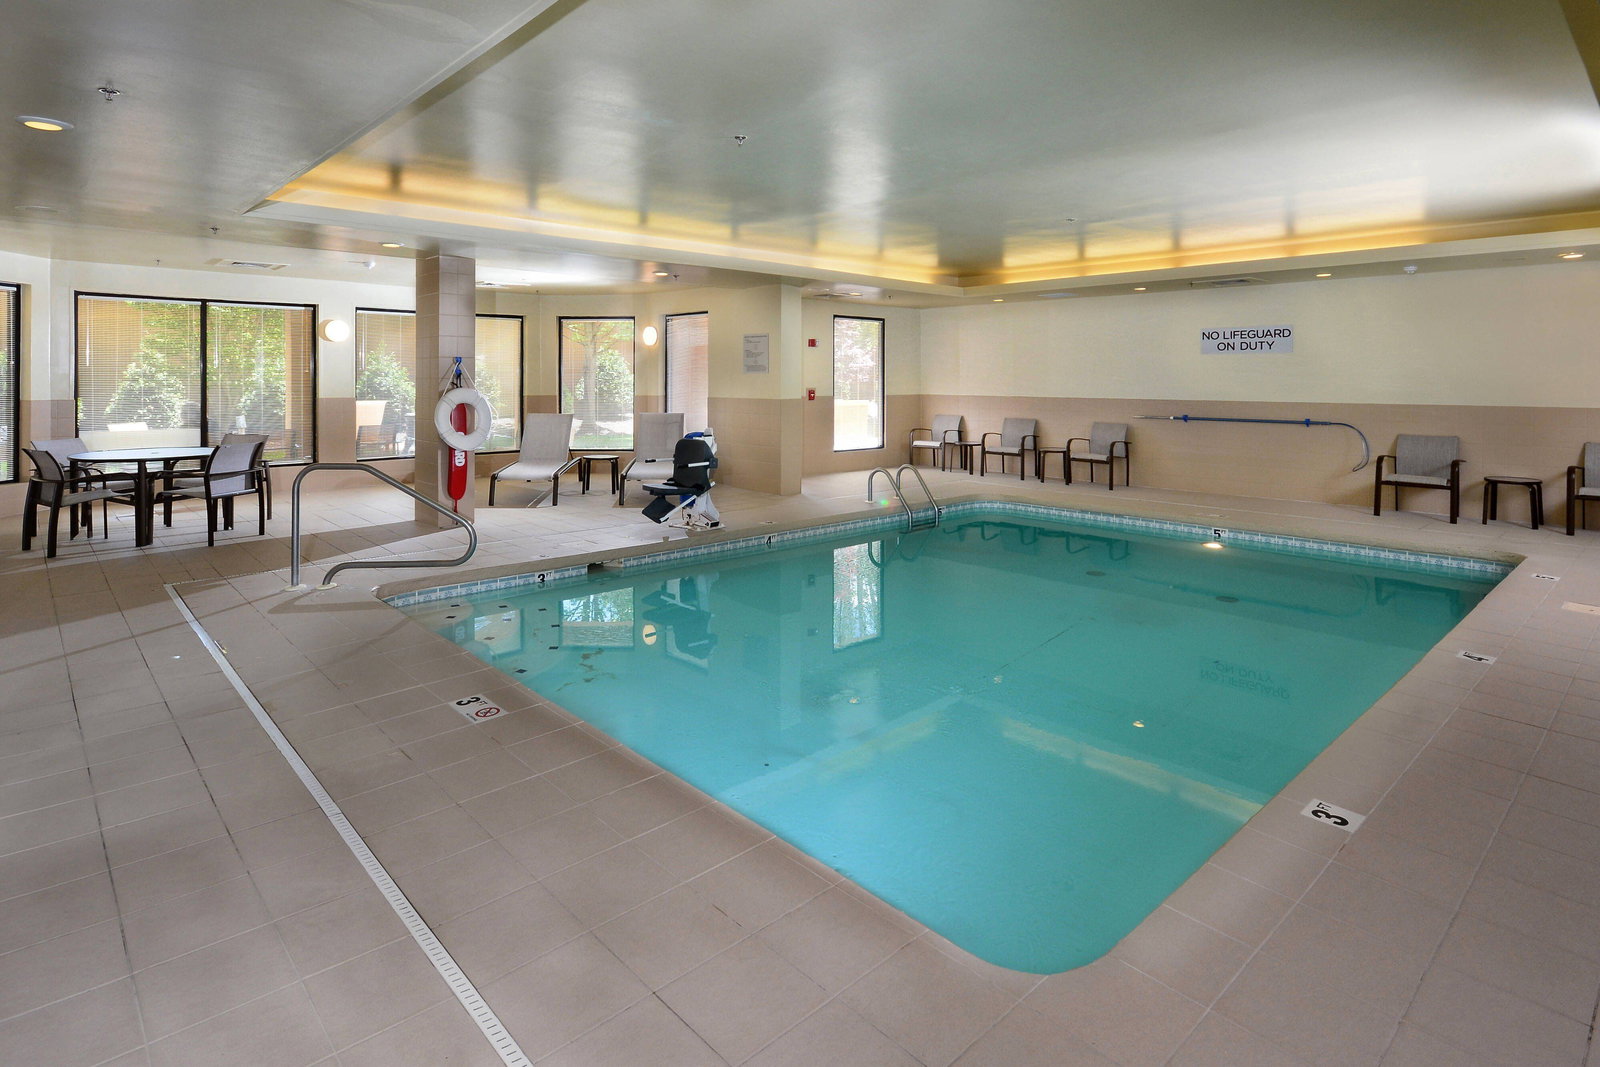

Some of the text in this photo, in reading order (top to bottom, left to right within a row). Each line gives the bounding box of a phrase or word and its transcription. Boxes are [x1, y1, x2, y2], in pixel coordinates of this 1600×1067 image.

[1202, 328, 1292, 341] NO LIFEGUARD
[1217, 340, 1275, 351] ON DUTY
[1213, 528, 1221, 538] 5
[765, 535, 771, 544] 4
[537, 573, 546, 583] 3
[456, 696, 481, 706] 3
[1311, 802, 1349, 827] 3 FT
